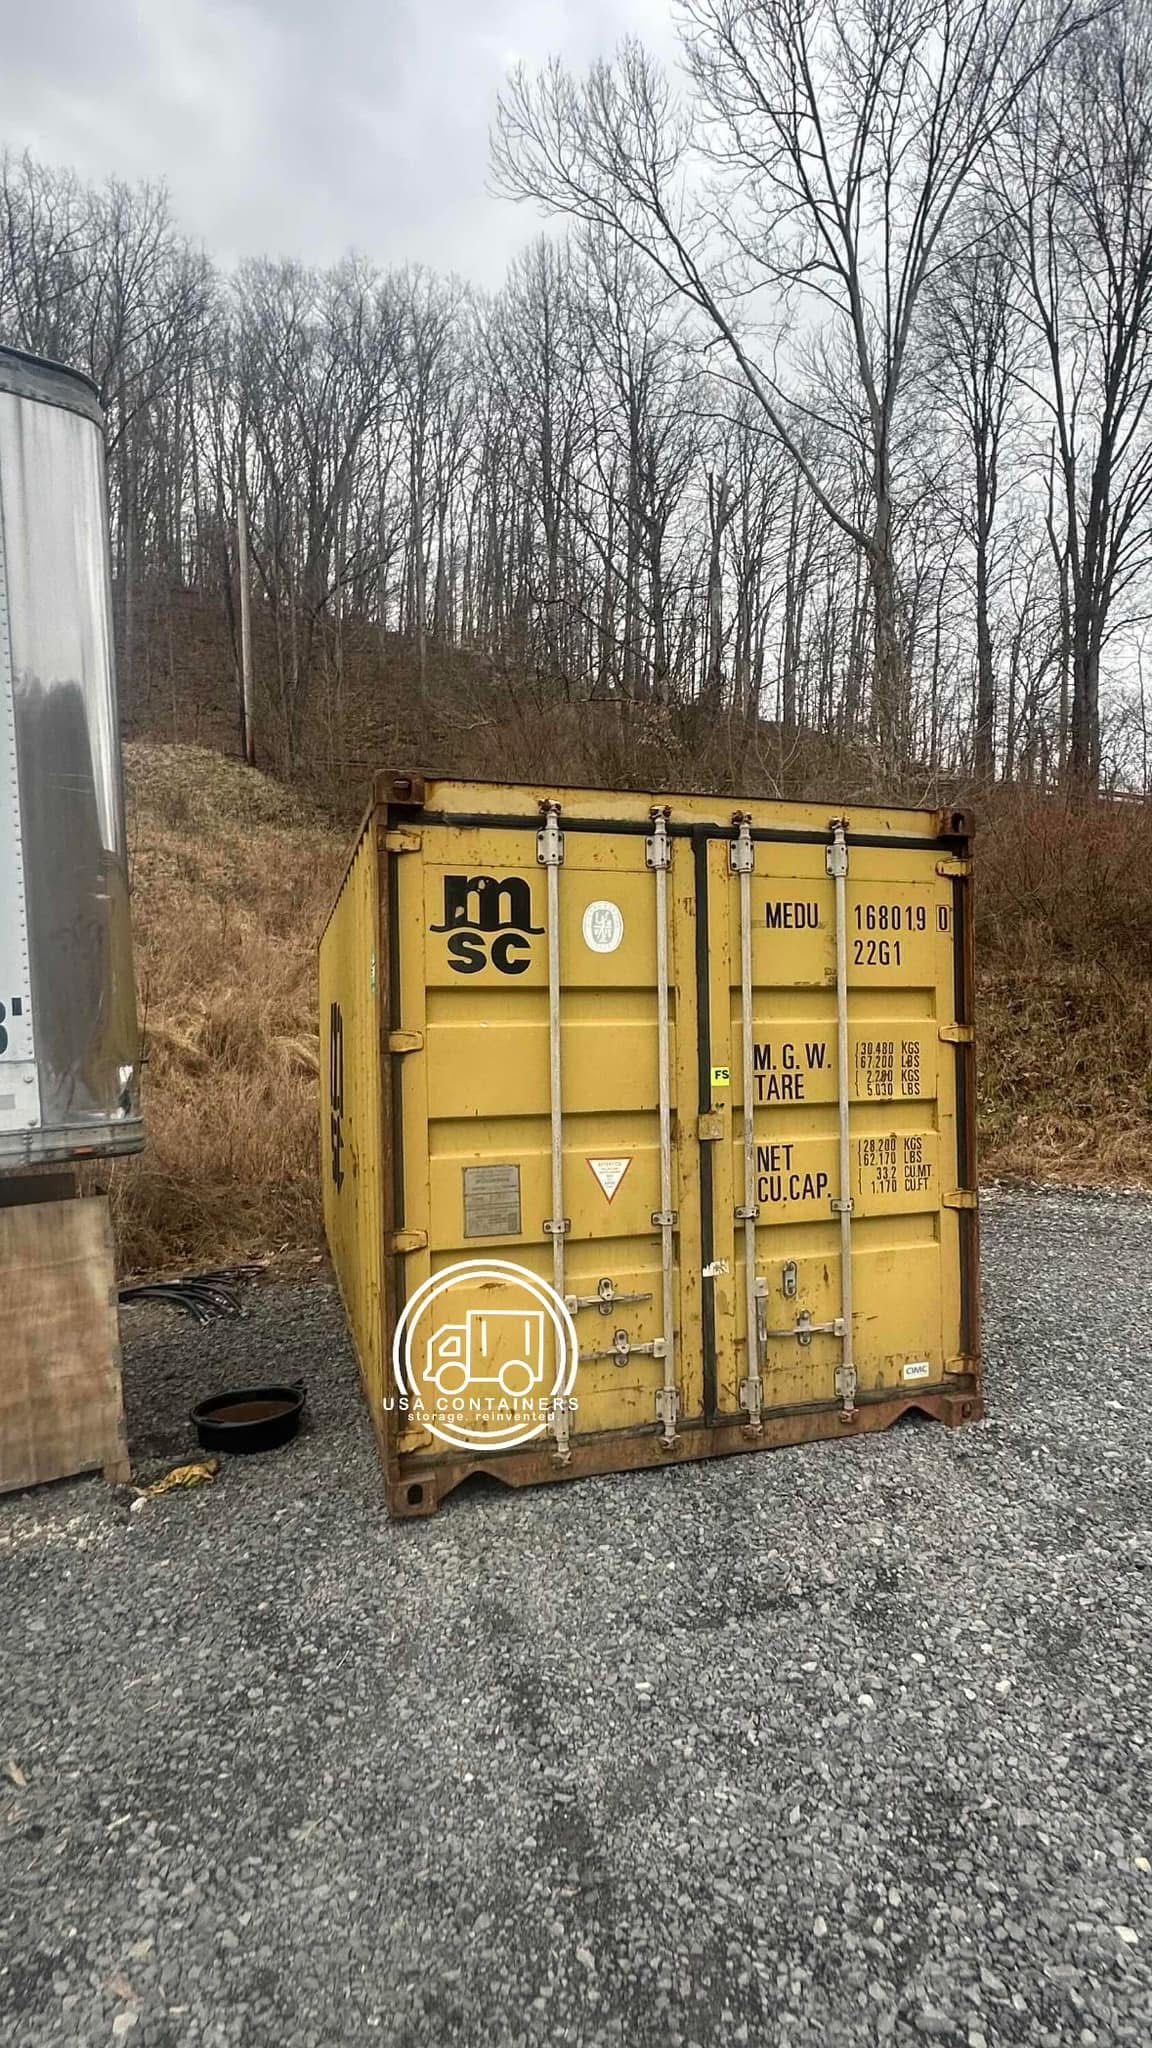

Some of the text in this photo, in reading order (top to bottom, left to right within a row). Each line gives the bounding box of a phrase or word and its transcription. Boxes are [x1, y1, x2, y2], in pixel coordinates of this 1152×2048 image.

[765, 902, 948, 931] MEDU 168019 0
[854, 940, 901, 966] 22G1
[860, 1040, 920, 1055] 30.480 KGS
[860, 1055, 920, 1069] 67.200 LBS
[715, 1069, 730, 1080] FS
[901, 1069, 920, 1082] KGS
[754, 1073, 805, 1101] TARE
[901, 1082, 920, 1096] LBS
[904, 1137, 922, 1151] KGS
[757, 1144, 794, 1173] NET
[863, 1151, 922, 1167] 62.170 LBS
[757, 1172, 832, 1202] CU.CAP.
